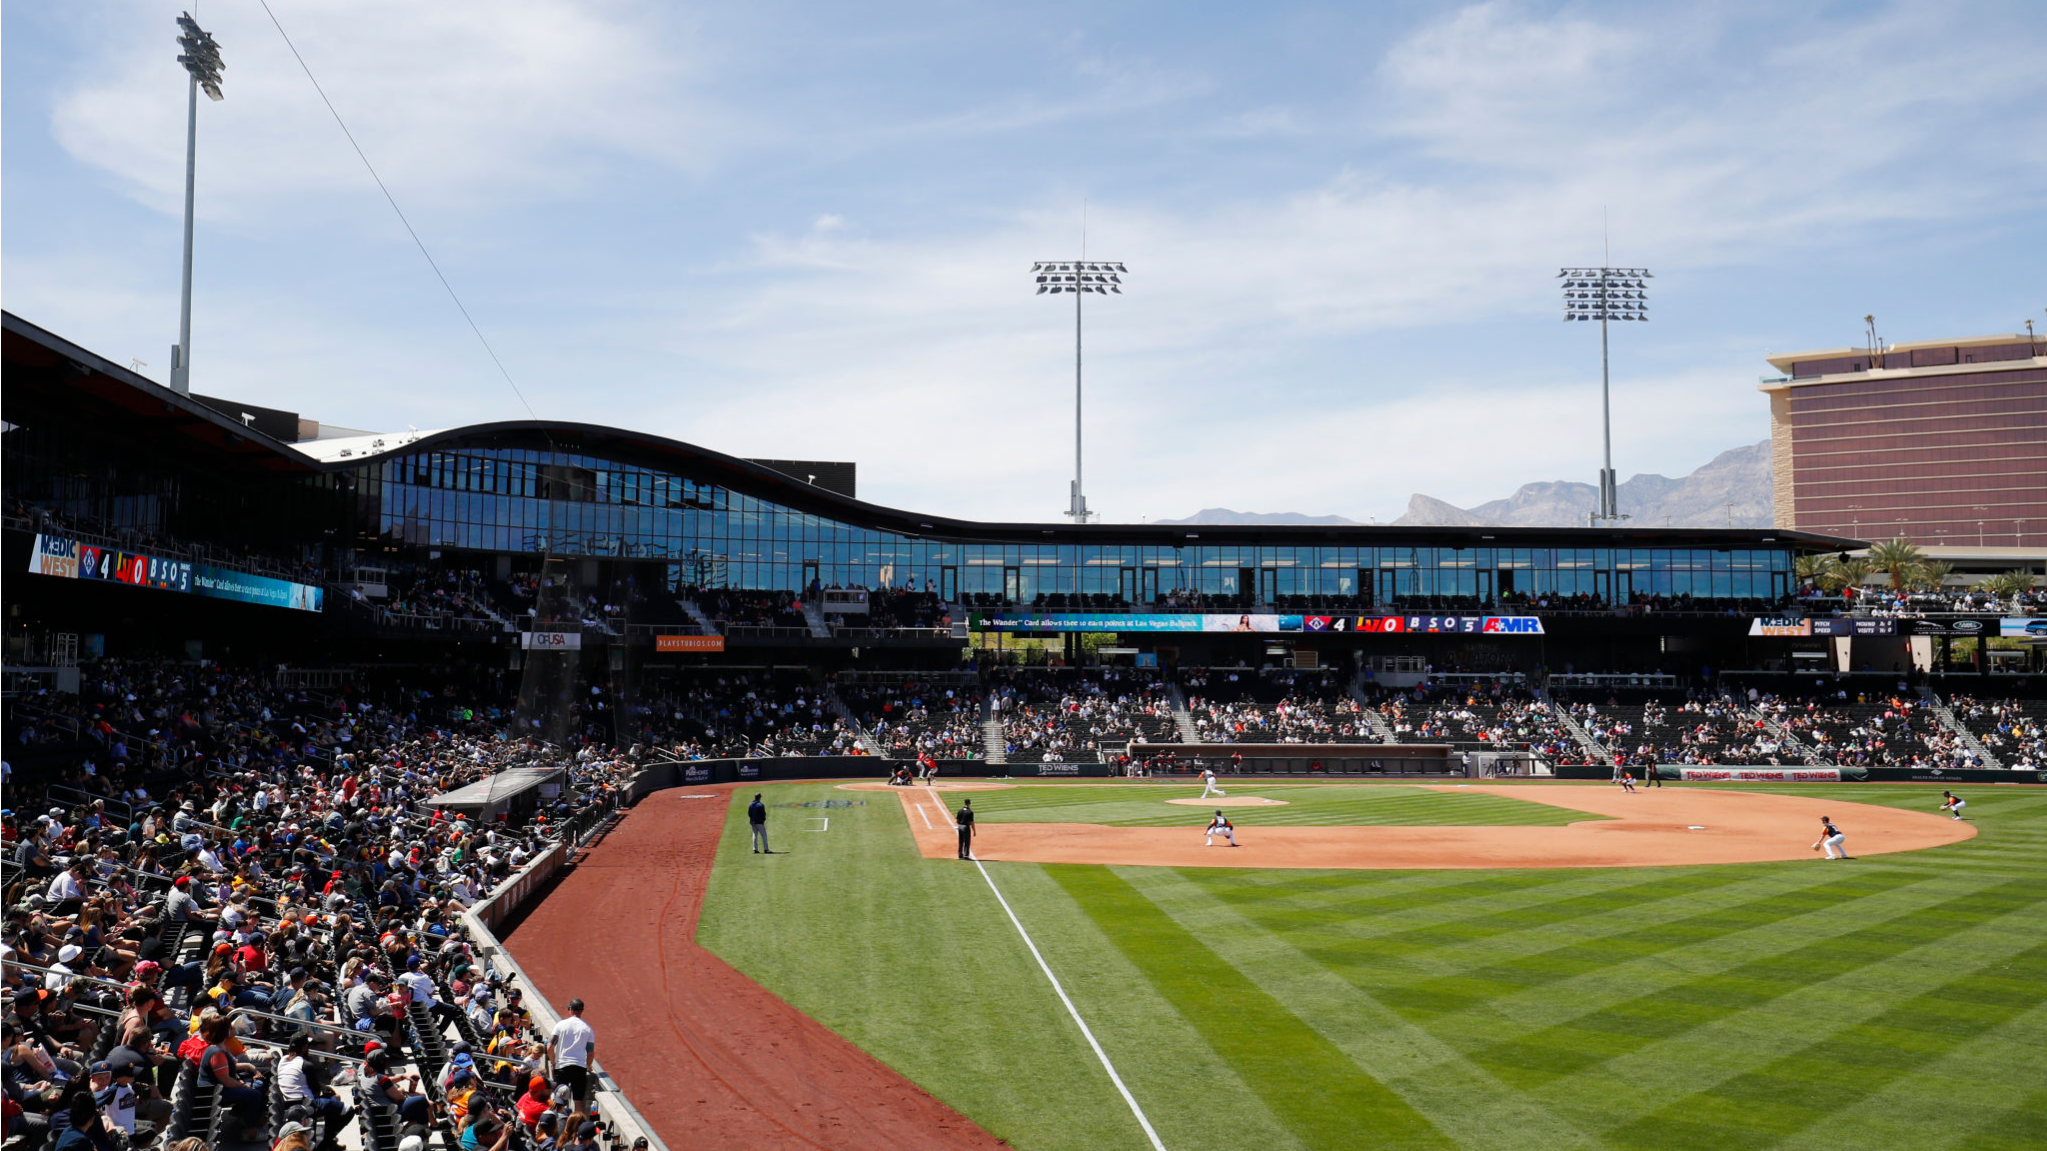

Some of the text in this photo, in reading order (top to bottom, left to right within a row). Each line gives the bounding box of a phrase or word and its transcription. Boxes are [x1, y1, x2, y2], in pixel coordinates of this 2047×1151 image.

[41, 535, 76, 559] MEDIC
[41, 555, 76, 578] WEST
[101, 553, 110, 579] 4
[134, 559, 143, 584] 0
[150, 558, 178, 582] B S O
[180, 571, 188, 591] 5
[1333, 618, 1346, 632] 4
[1384, 618, 1397, 632] 0
[1410, 617, 1456, 628] B S O
[1464, 621, 1474, 632] 5
[1483, 618, 1539, 632] AMR
[1760, 618, 1805, 627] MEDIC
[1761, 627, 1805, 636] WEST
[659, 639, 722, 647] PLAYSTUDIOS.COM
[1038, 763, 1080, 772] TED WIENS
[1686, 771, 1701, 779] TED
[1739, 771, 1755, 779] TED
[1792, 771, 1837, 780] TED WIENS
